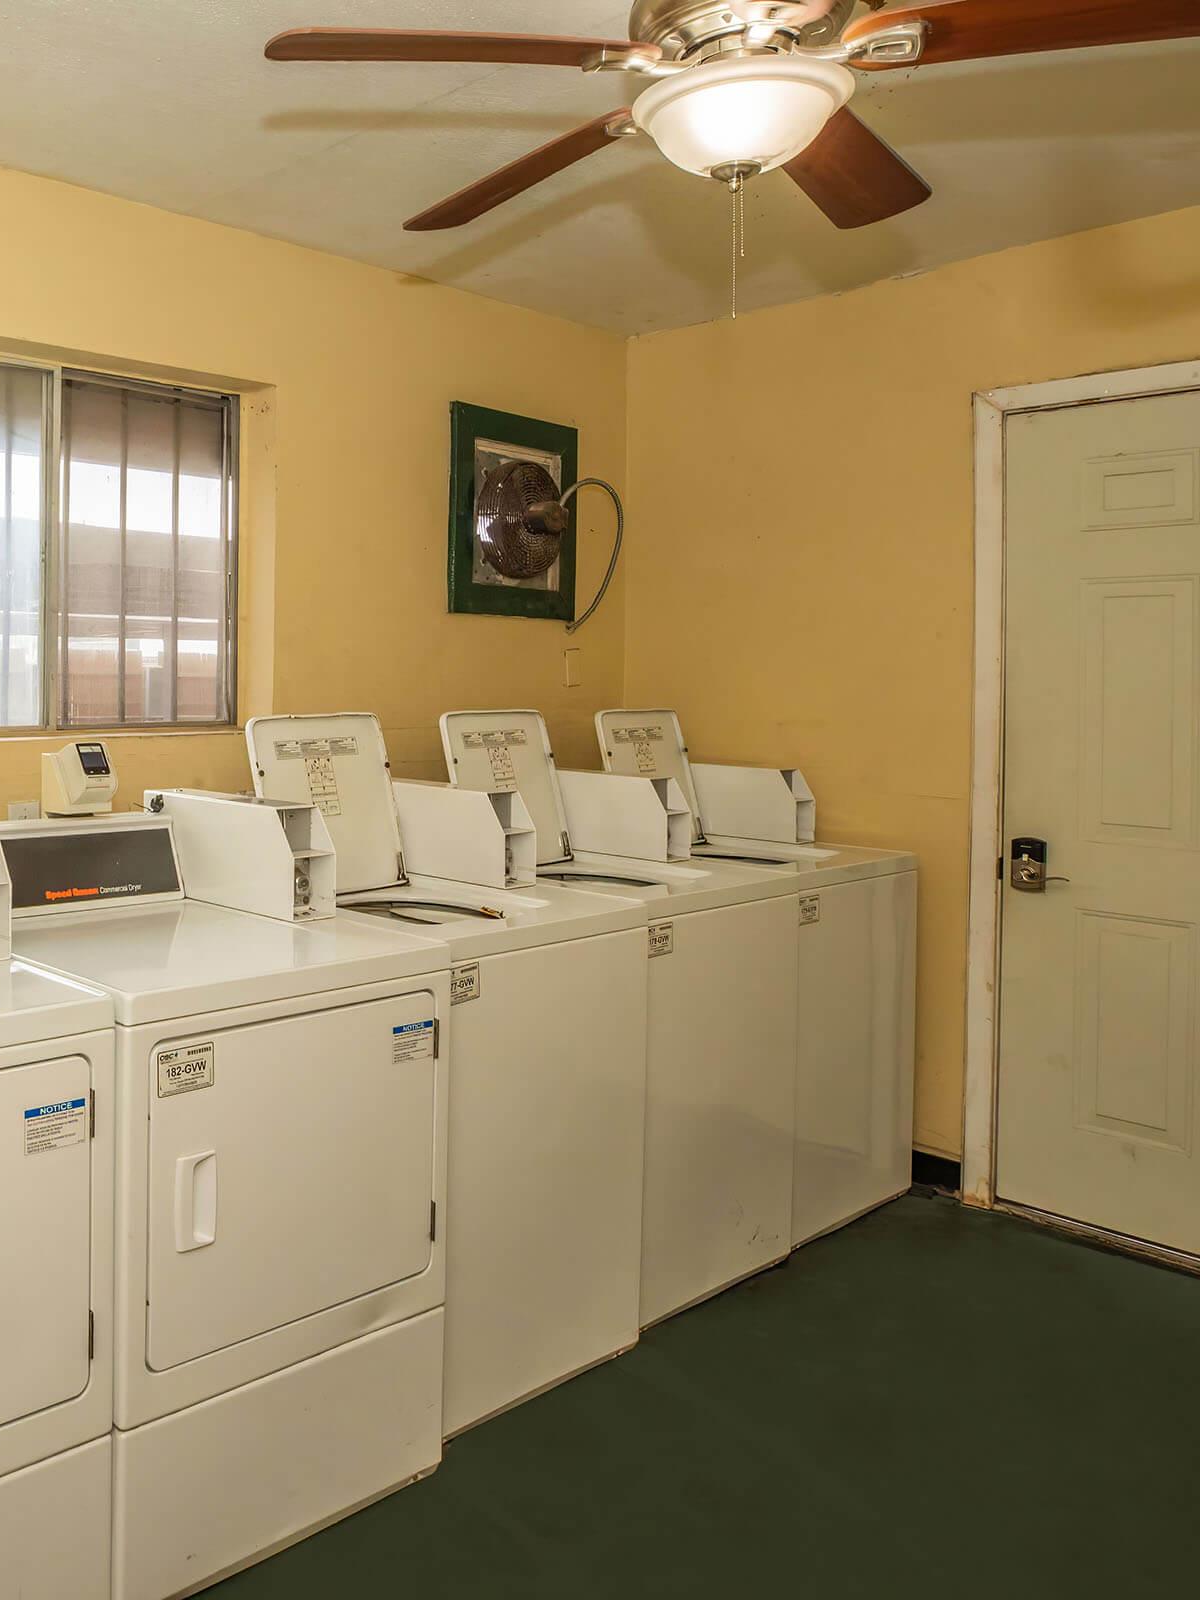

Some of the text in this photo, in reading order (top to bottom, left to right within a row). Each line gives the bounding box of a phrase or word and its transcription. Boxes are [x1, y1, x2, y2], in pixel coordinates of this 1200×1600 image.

[45, 889, 72, 900] Speed
[73, 888, 99, 896] Queen
[402, 1022, 424, 1032] NOTICE
[166, 1060, 206, 1078] 182-GVW
[40, 1102, 72, 1115] NOTICE
